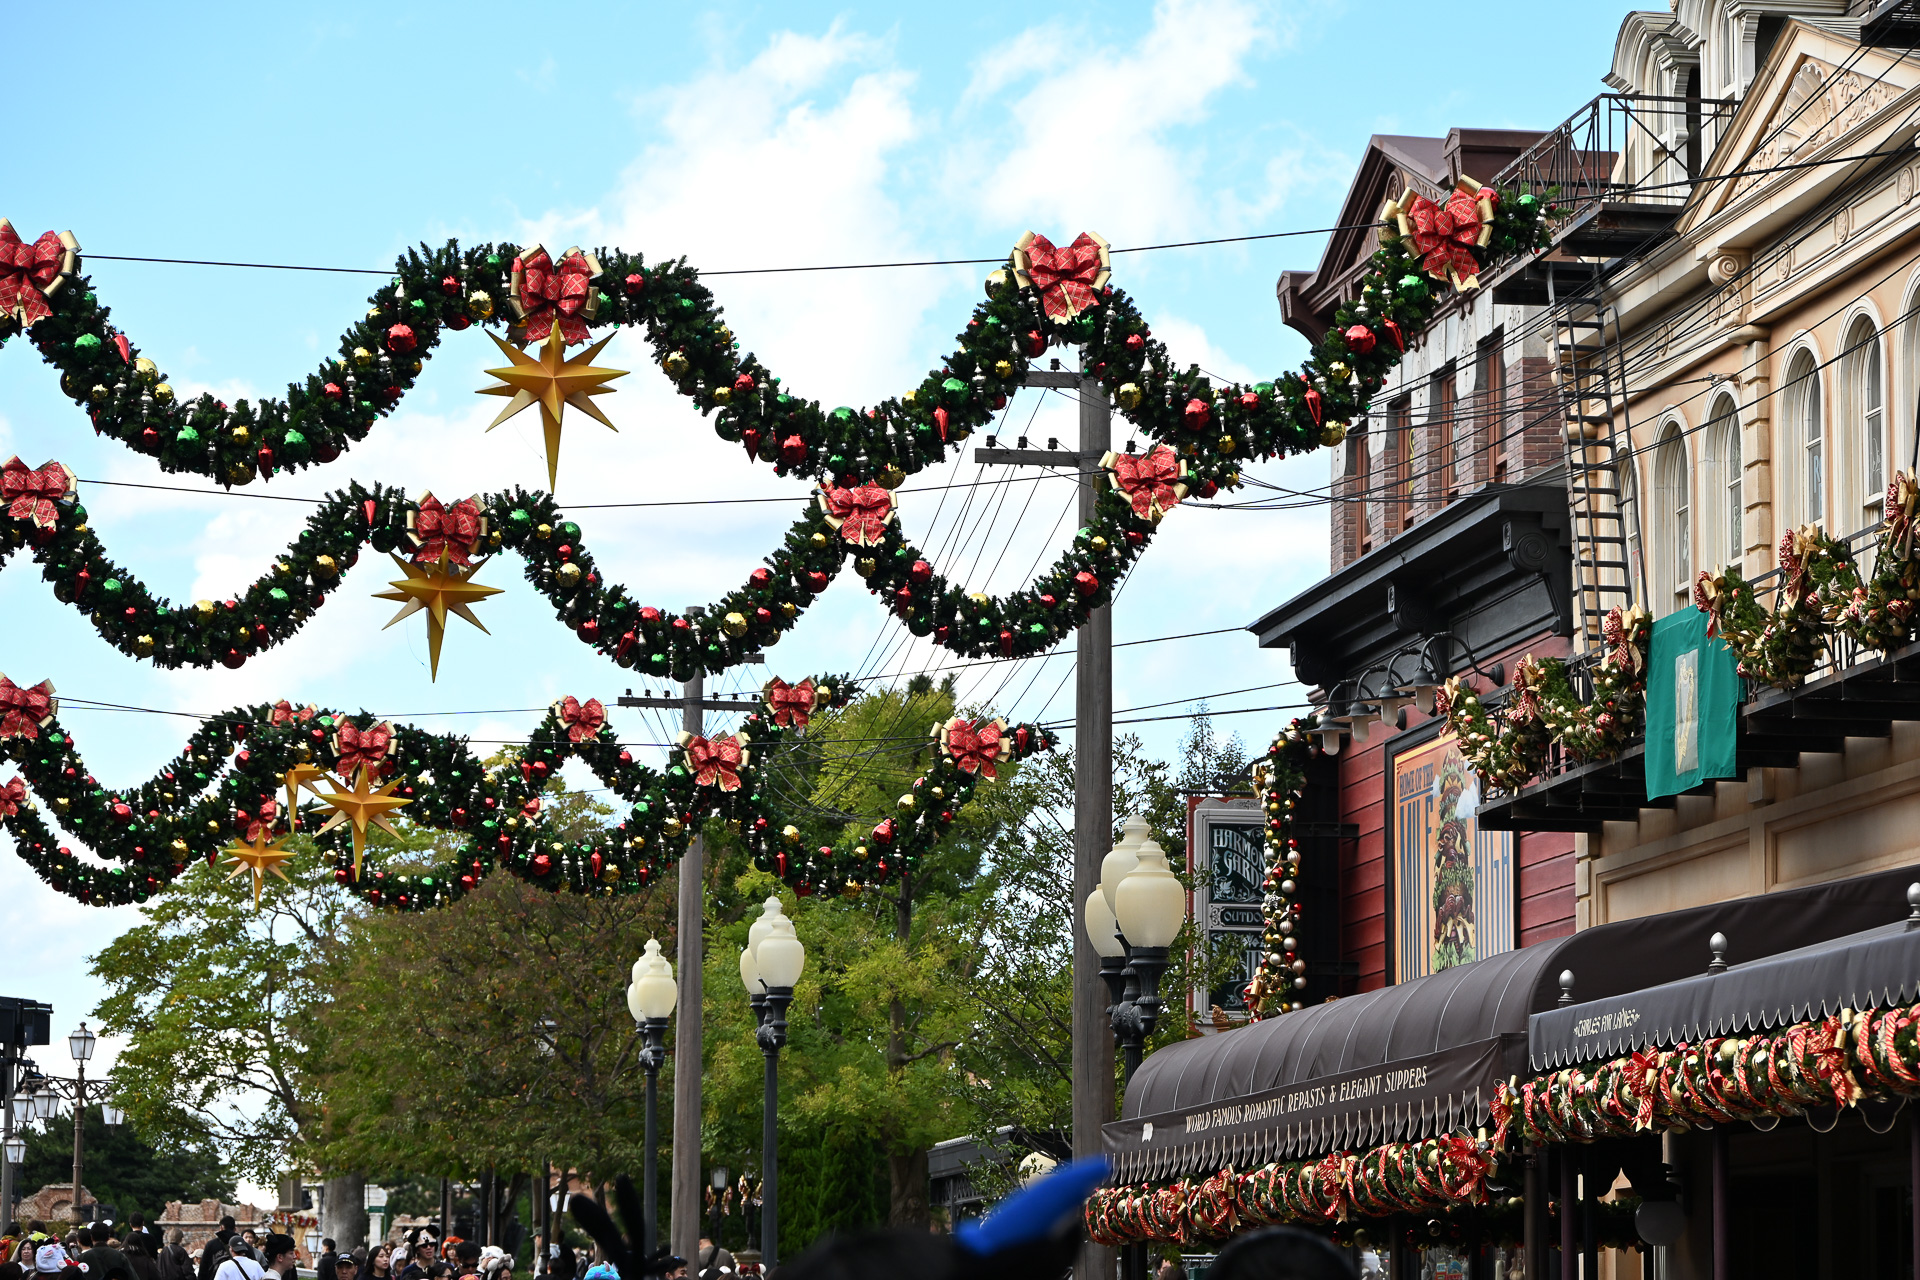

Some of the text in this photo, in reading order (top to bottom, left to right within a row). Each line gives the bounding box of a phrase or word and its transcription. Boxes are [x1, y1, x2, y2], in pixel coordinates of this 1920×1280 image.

[1223, 911, 1264, 923] OUTDO
[1185, 1065, 1428, 1134] WORLD FAMOUS ROMANTIC REPASTS & ELEGANT SUPPERS
